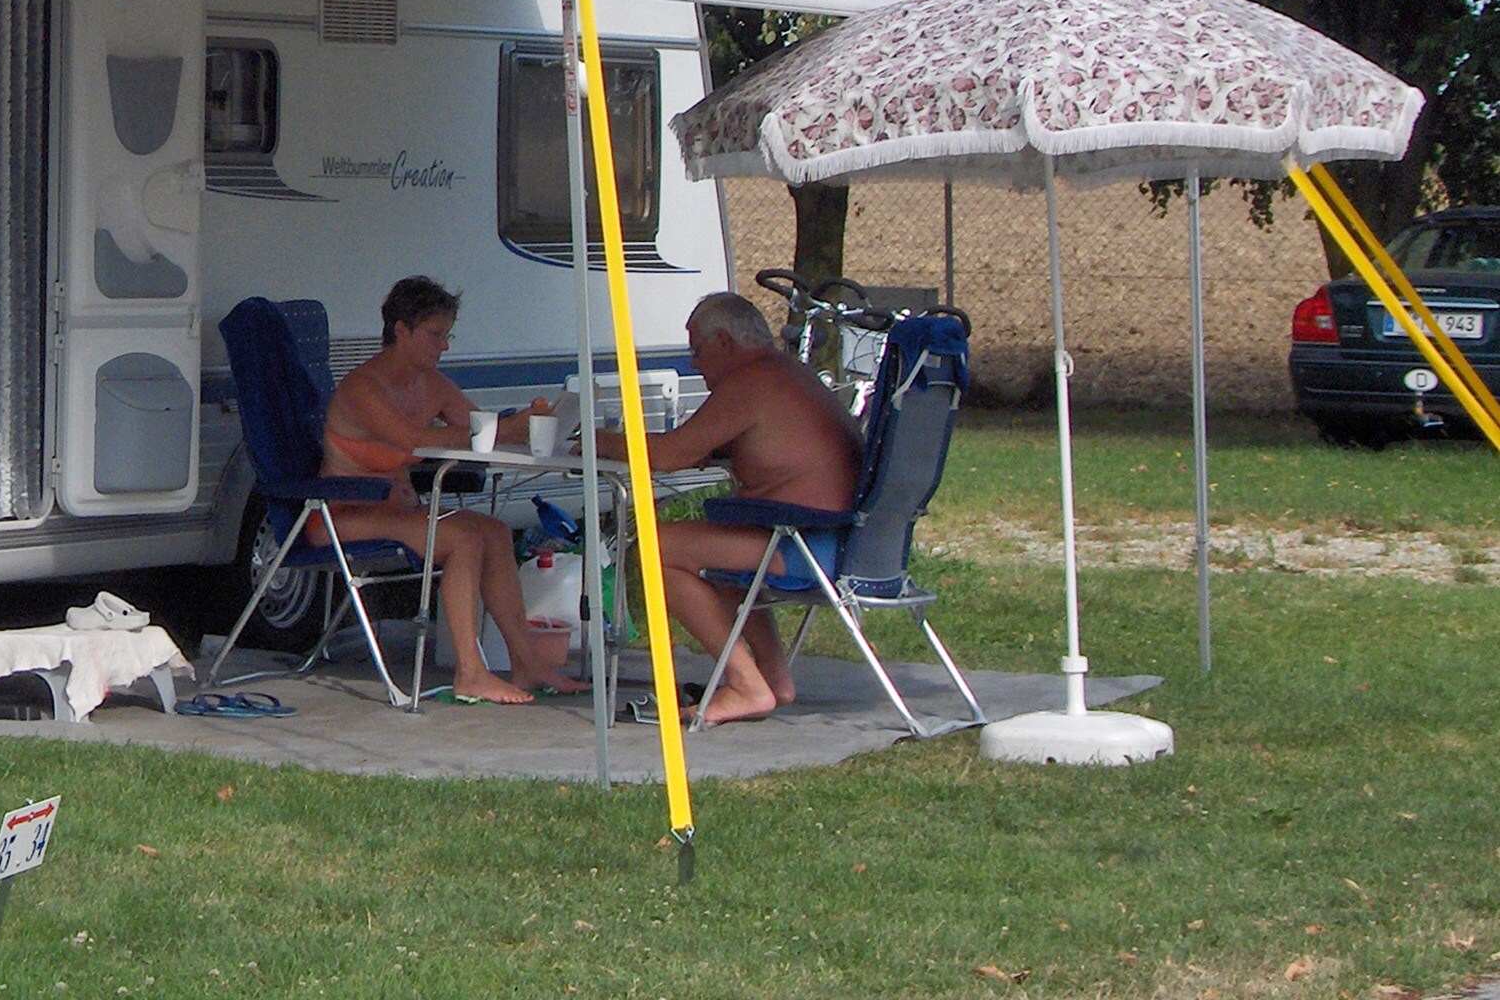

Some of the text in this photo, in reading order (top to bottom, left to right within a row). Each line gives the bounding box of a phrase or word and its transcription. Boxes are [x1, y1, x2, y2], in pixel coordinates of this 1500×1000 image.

[322, 150, 455, 190] Weltbummler Creation
[1445, 316, 1475, 332] 943
[1416, 372, 1428, 388] D
[26, 821, 51, 862] 34
